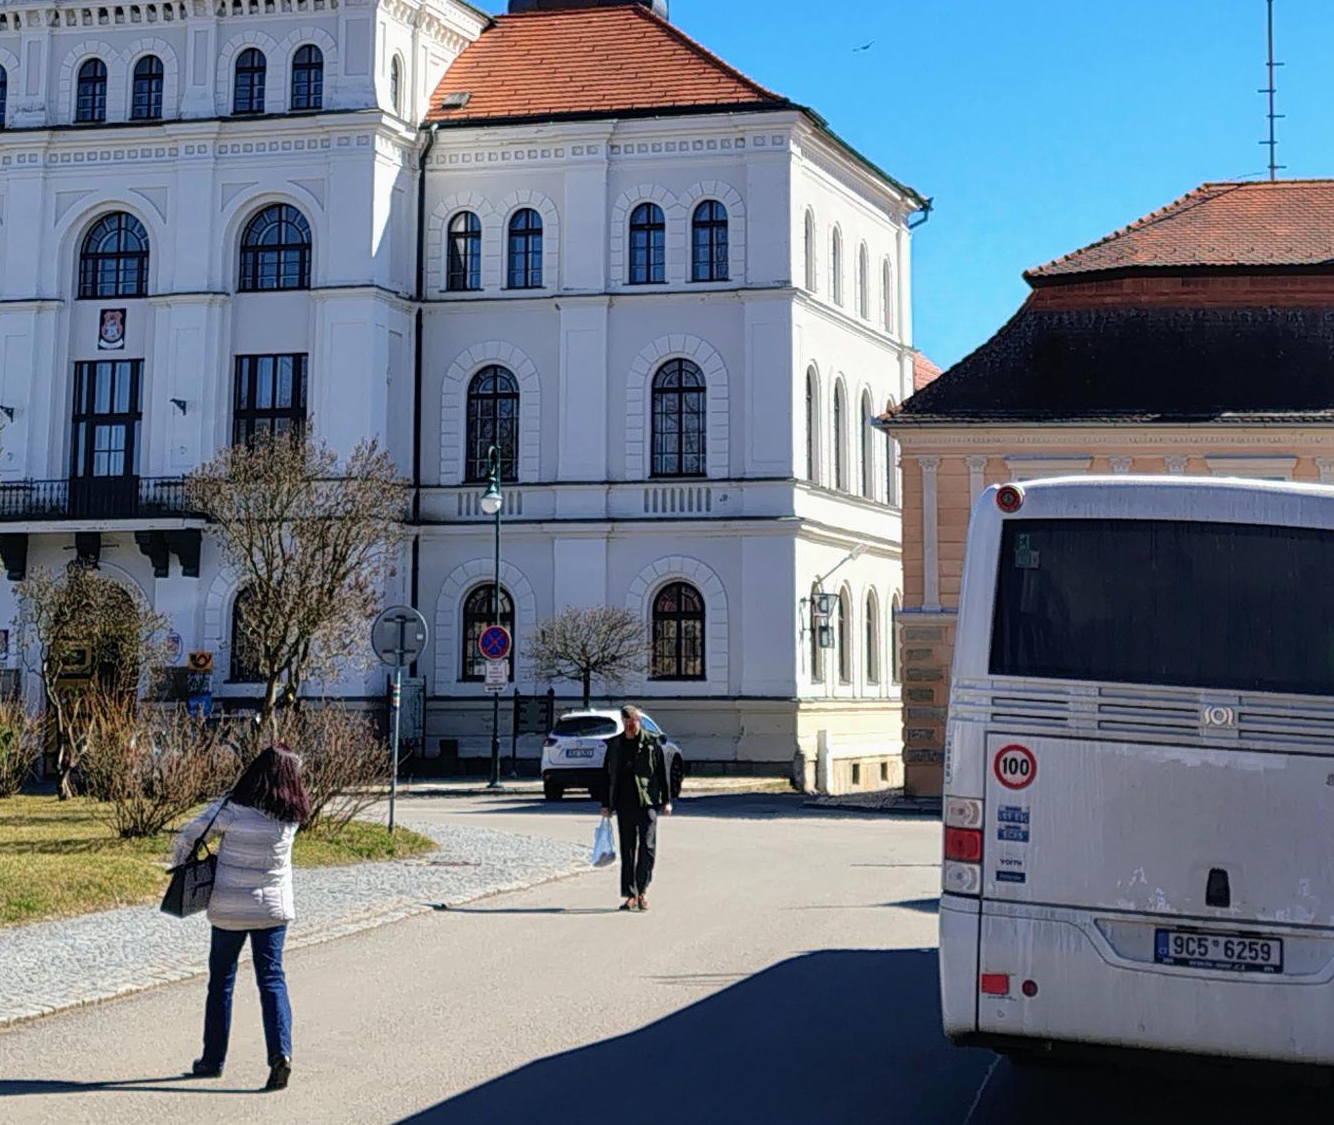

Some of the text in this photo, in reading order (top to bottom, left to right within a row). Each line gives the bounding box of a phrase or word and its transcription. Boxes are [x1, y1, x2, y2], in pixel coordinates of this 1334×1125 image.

[1002, 757, 1029, 776] 100
[1173, 935, 1271, 962] 9C5 6259
